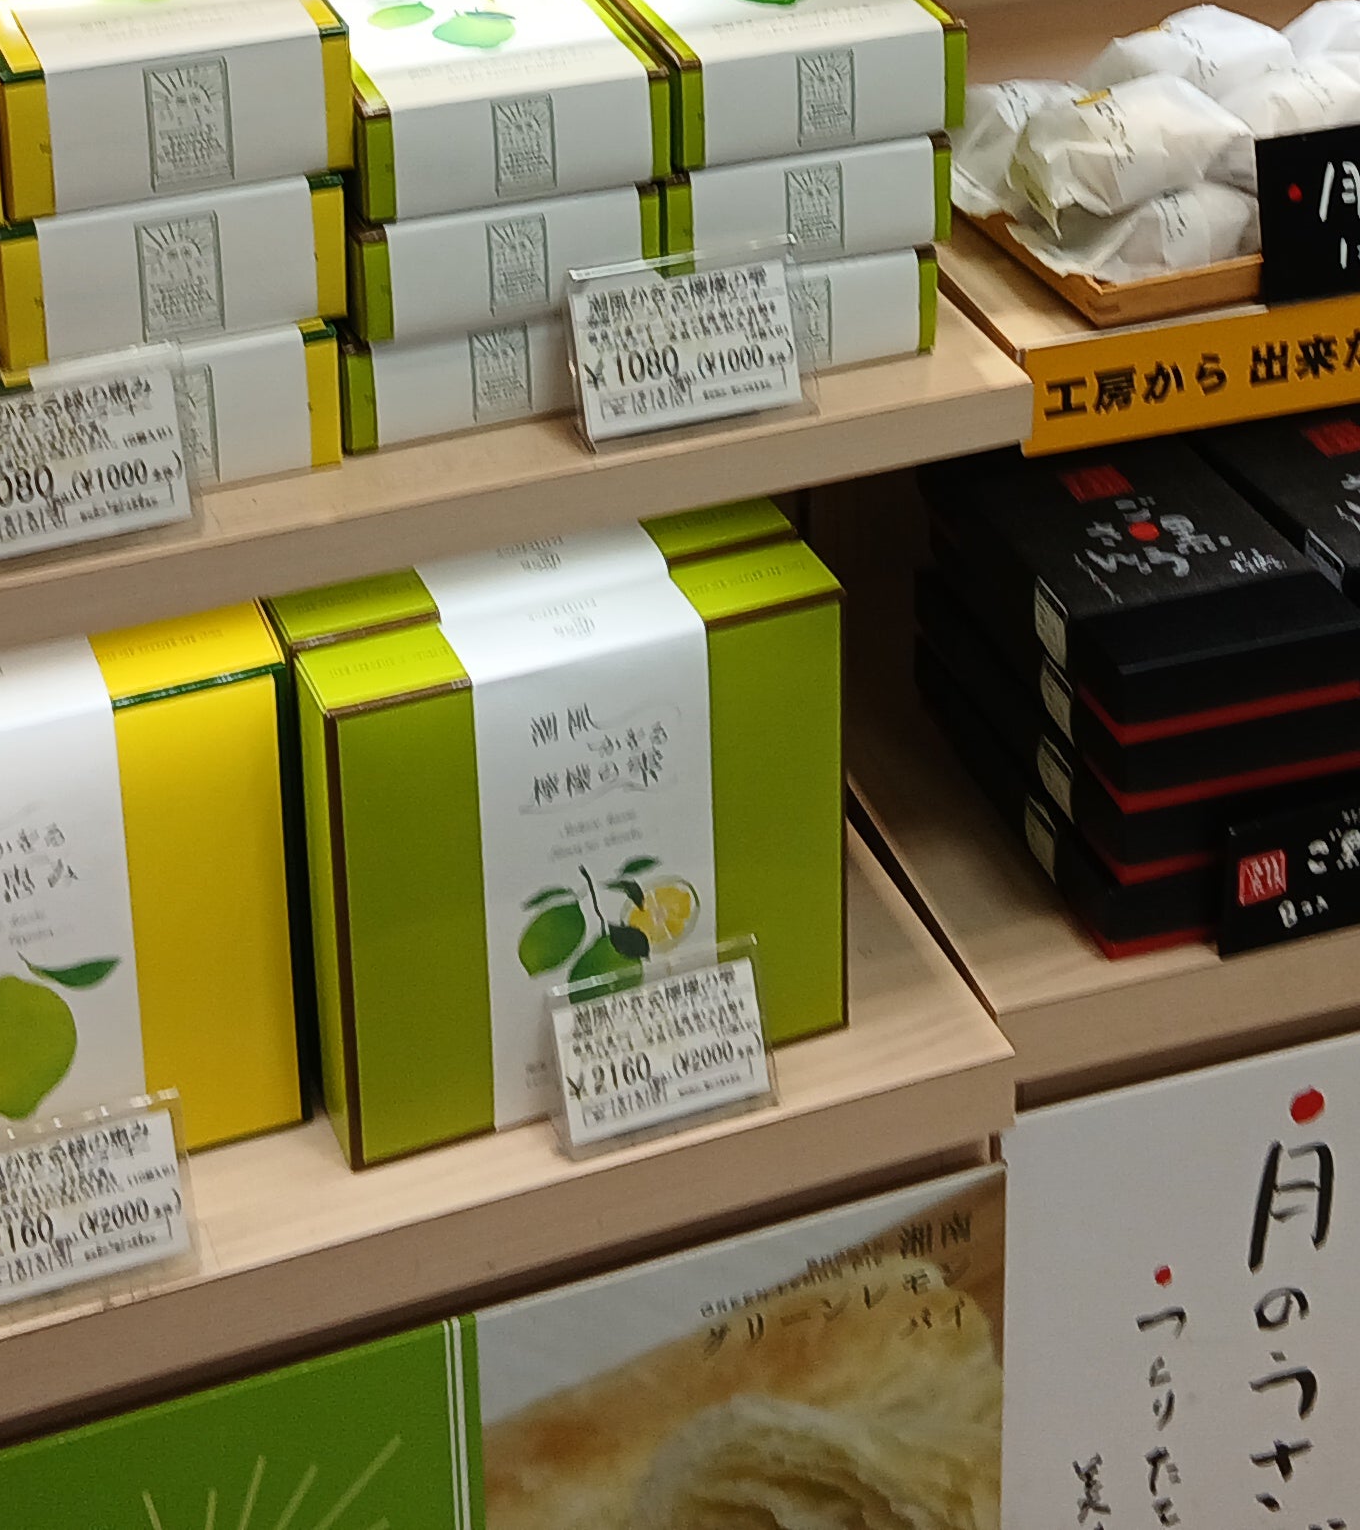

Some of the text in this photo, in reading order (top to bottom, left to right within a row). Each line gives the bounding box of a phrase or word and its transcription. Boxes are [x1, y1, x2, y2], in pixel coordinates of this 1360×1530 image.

[582, 343, 682, 392] ¥1080
[566, 1050, 654, 1102] ¥2160
[1247, 1139, 1346, 1530] 月のうさ
